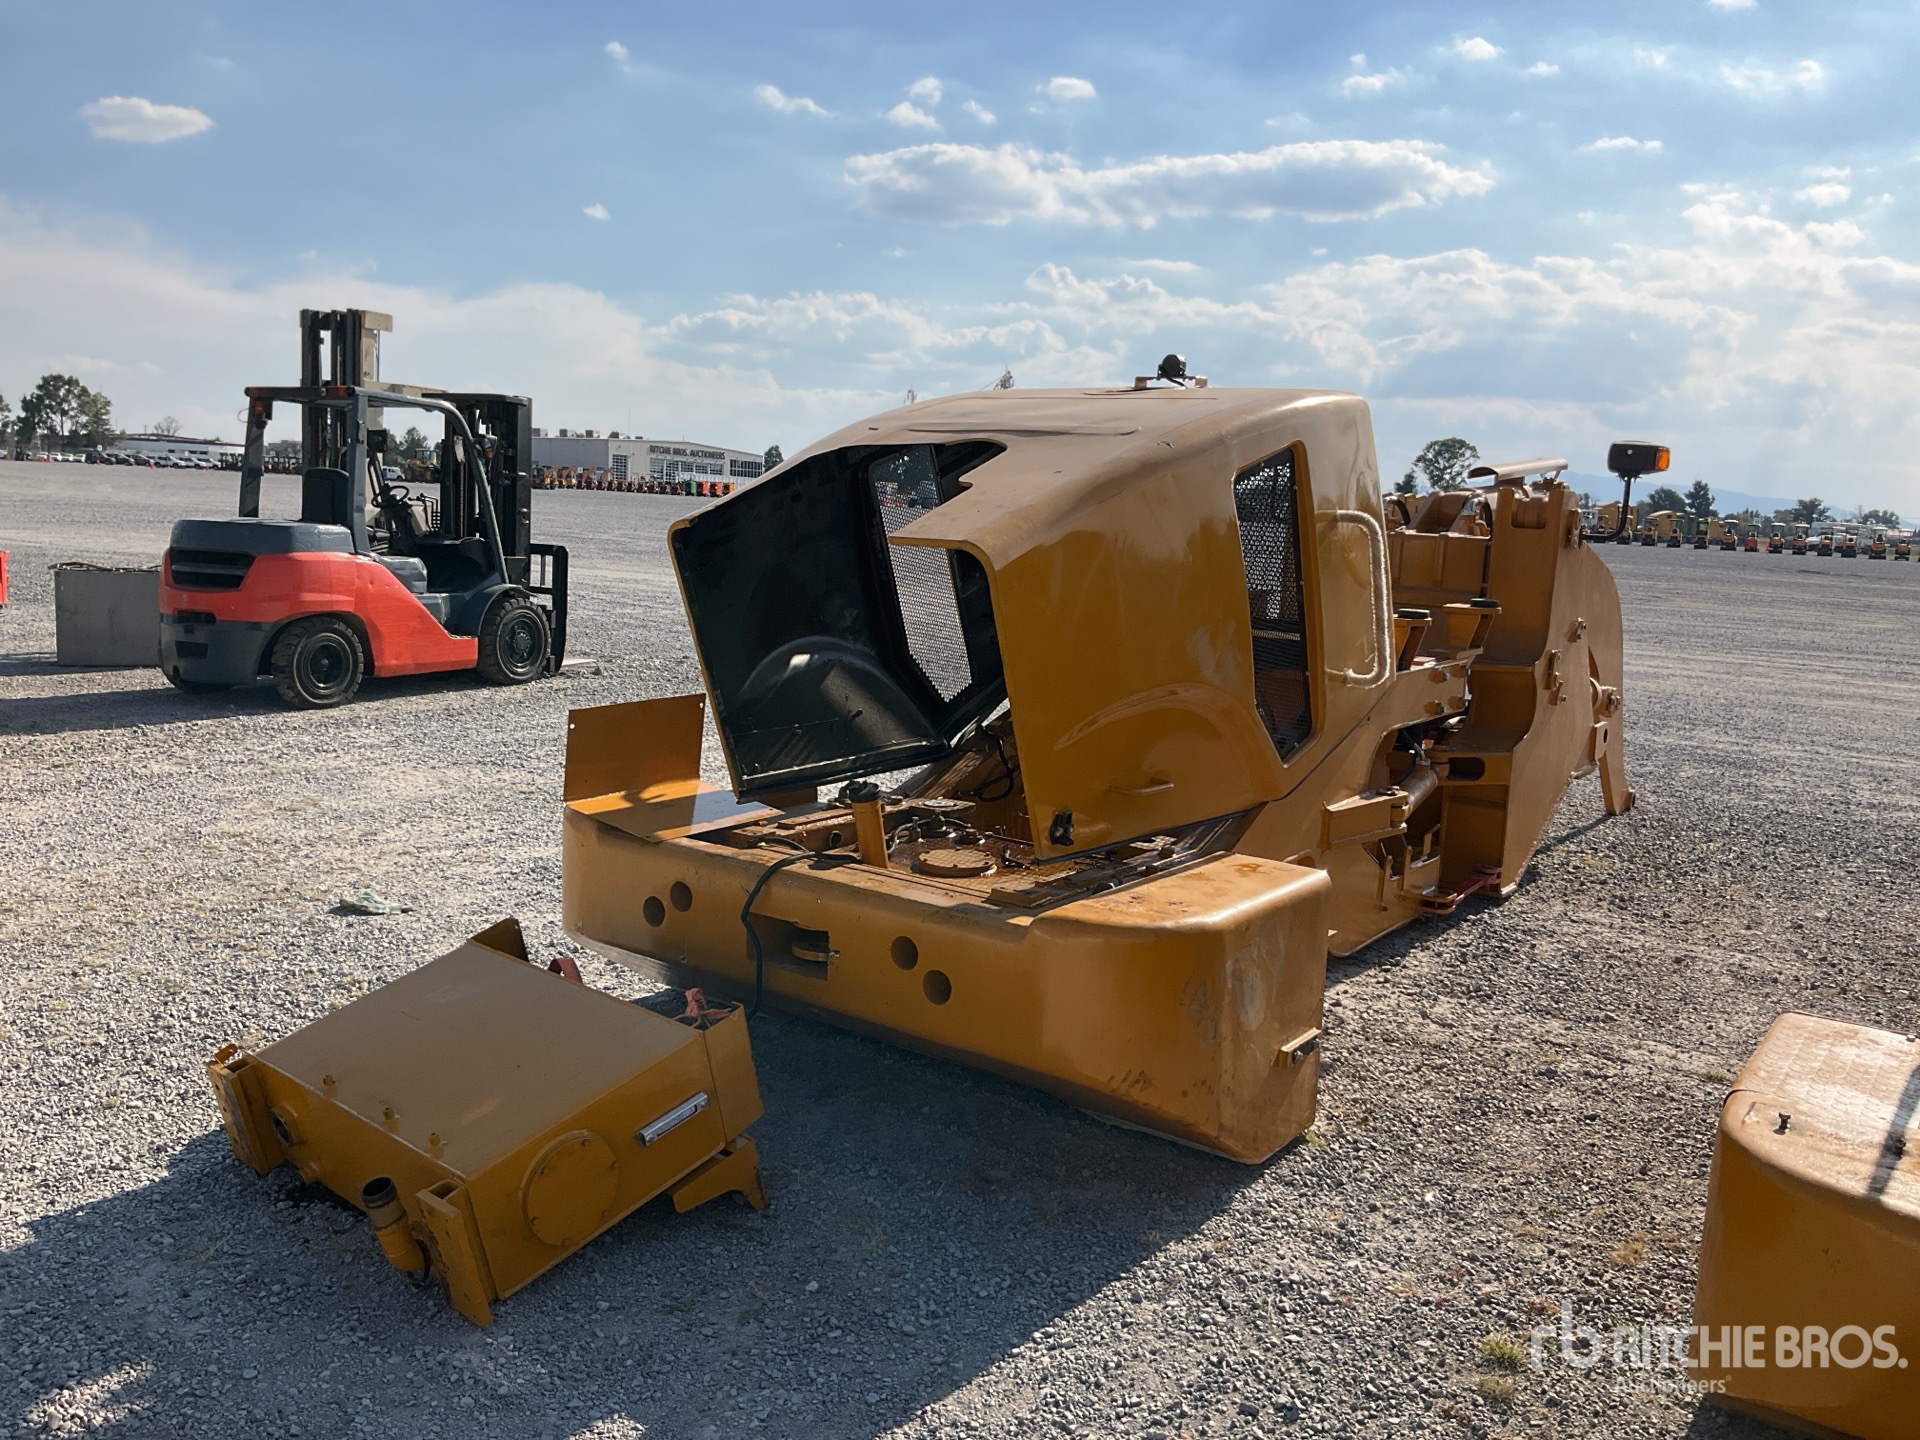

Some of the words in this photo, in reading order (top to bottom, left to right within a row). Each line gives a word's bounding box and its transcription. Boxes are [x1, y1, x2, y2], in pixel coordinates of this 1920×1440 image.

[649, 445, 672, 455] RITCHIE
[672, 447, 689, 457] BROS.
[689, 449, 726, 460] AUCTIONEERS
